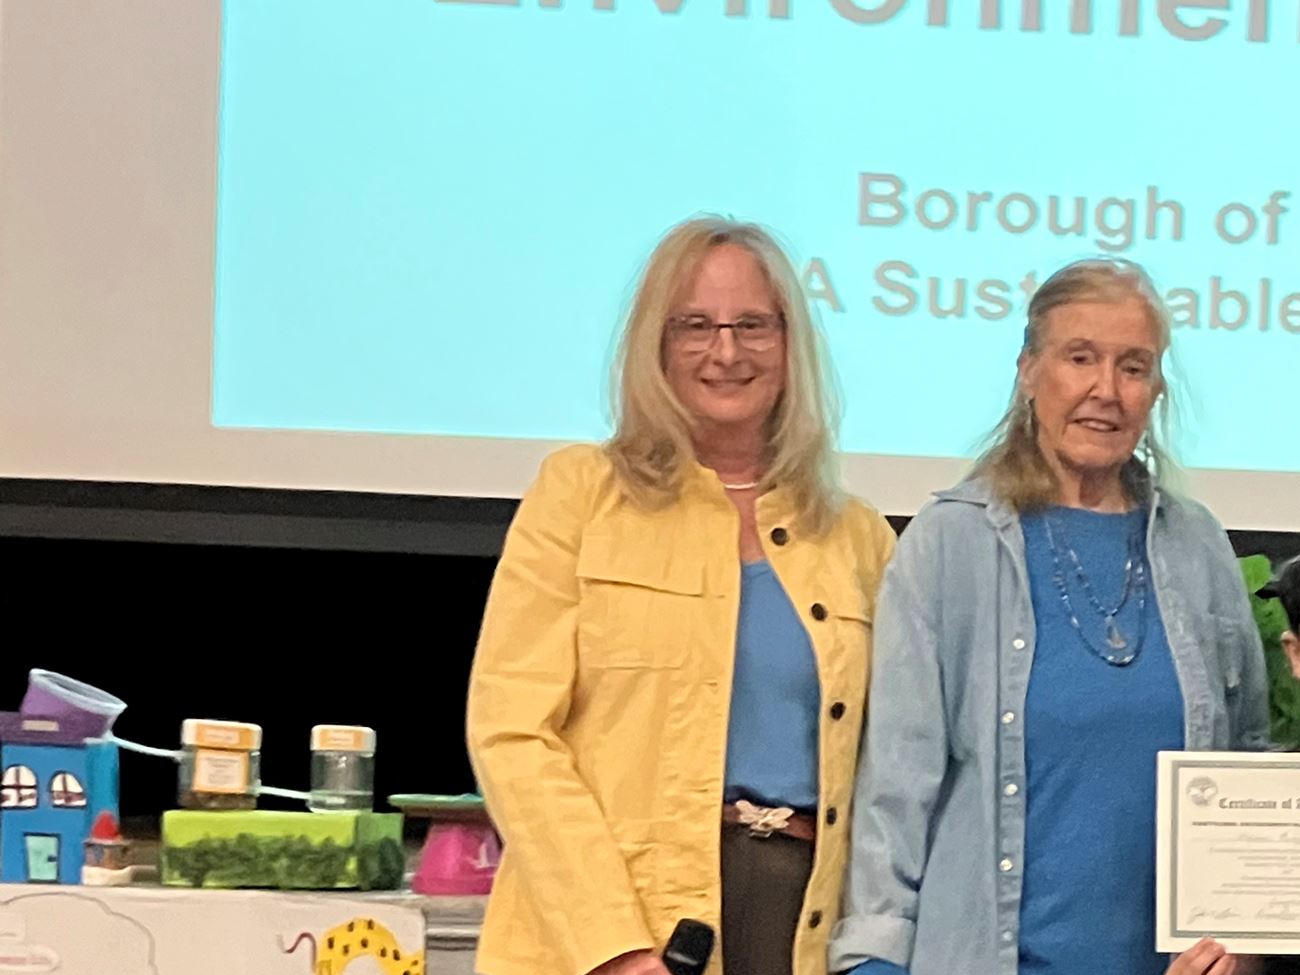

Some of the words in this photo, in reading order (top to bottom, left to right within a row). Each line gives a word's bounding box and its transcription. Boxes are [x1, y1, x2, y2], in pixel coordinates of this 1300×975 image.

[858, 172, 1184, 252] Borough
[1214, 190, 1291, 245] of
[800, 257, 845, 313] A
